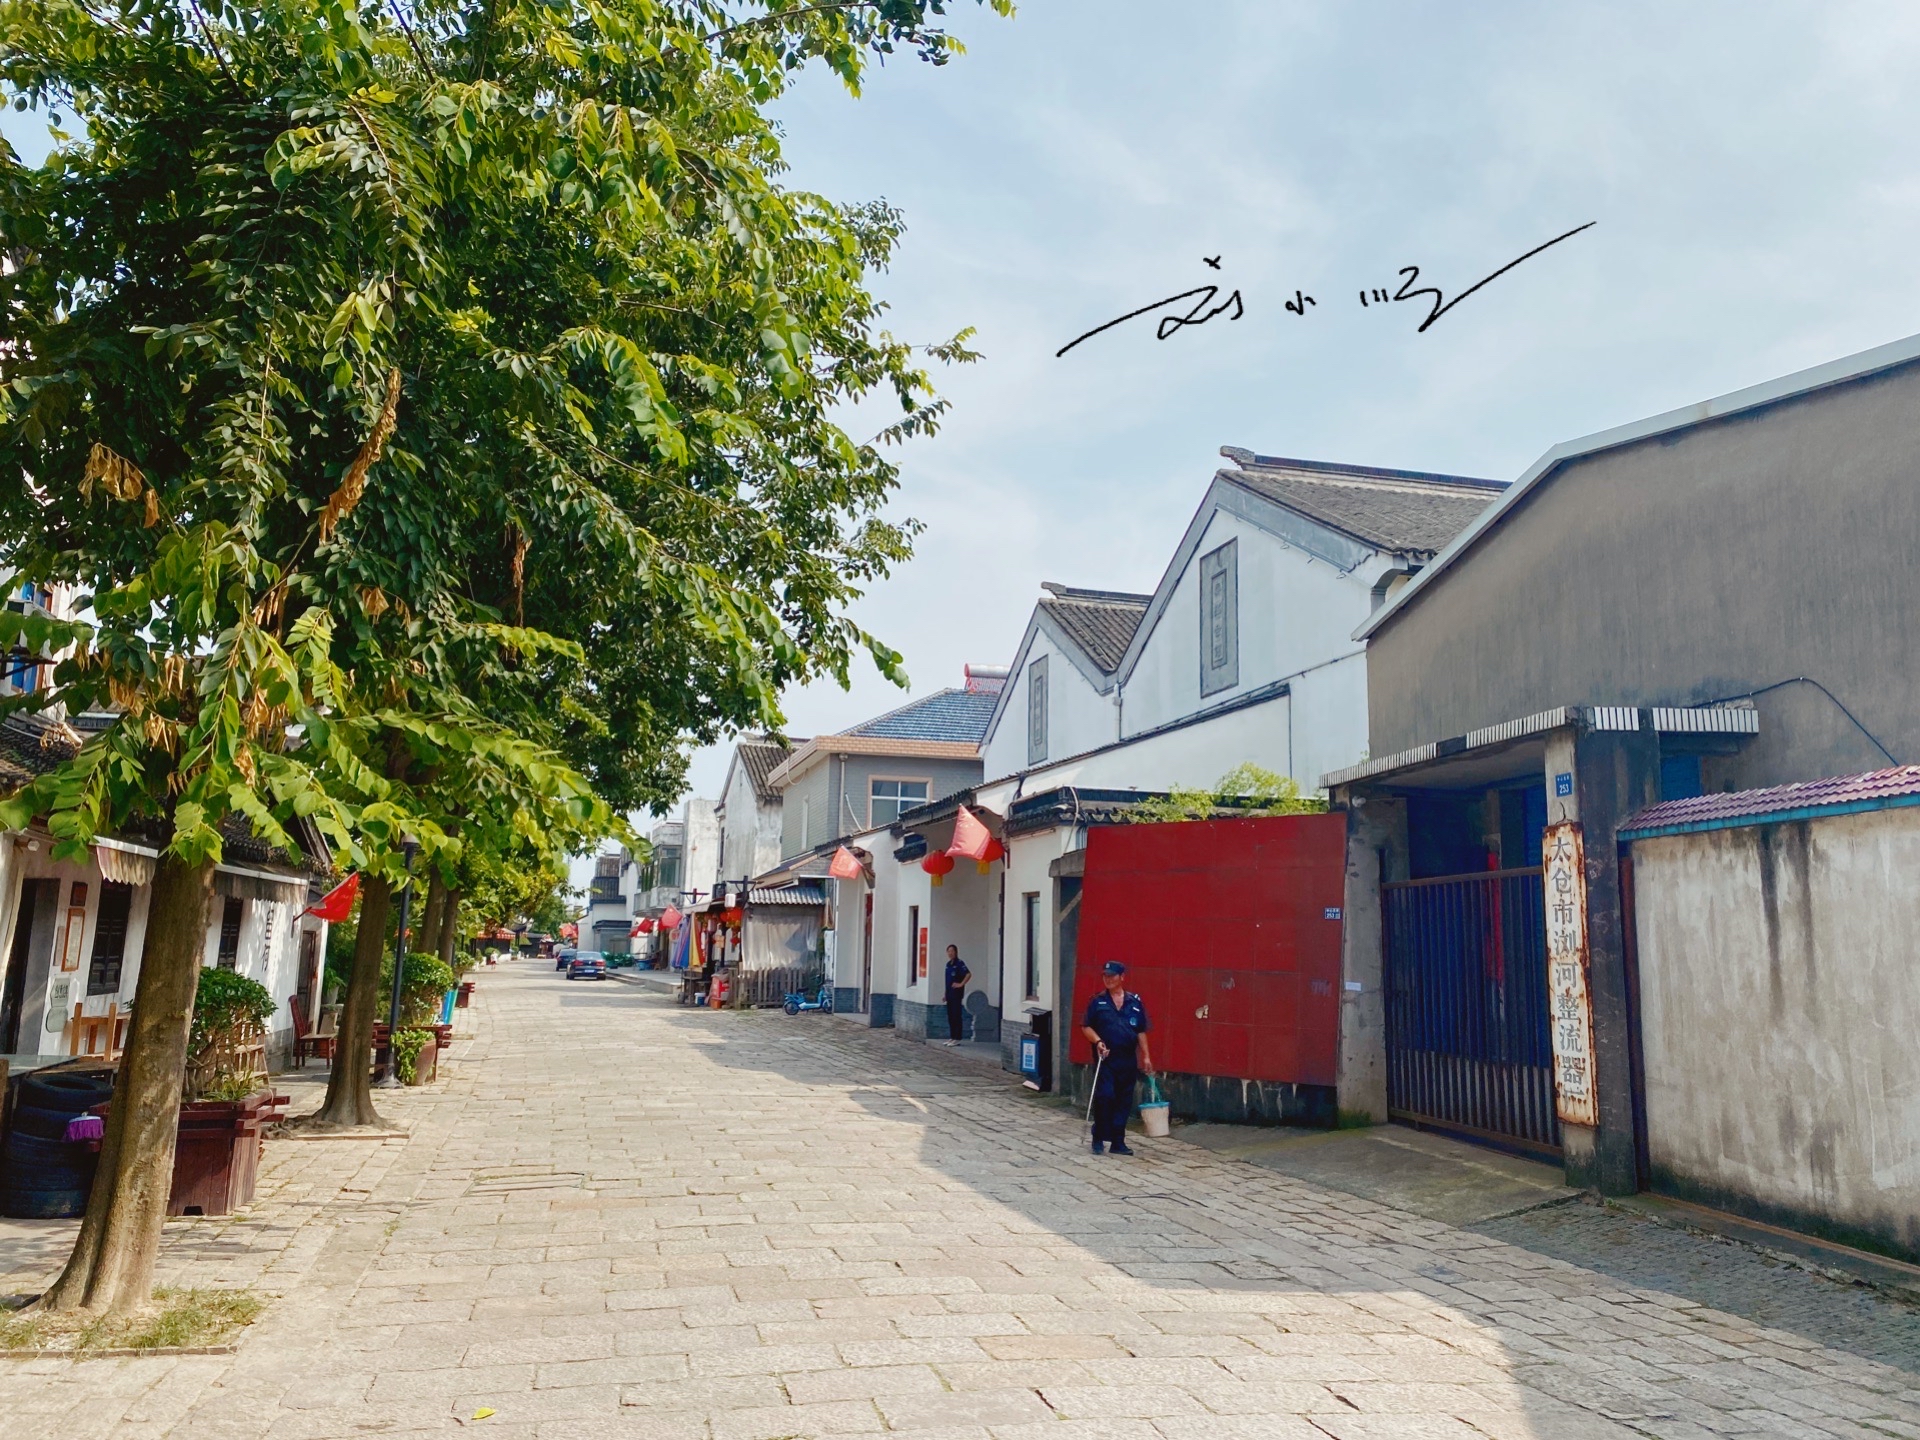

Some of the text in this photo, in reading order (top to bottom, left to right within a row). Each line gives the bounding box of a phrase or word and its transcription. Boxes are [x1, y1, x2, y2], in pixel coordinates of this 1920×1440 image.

[1559, 783, 1569, 794] 253
[1551, 837, 1585, 1113] 太仓市浏河整流器厂
